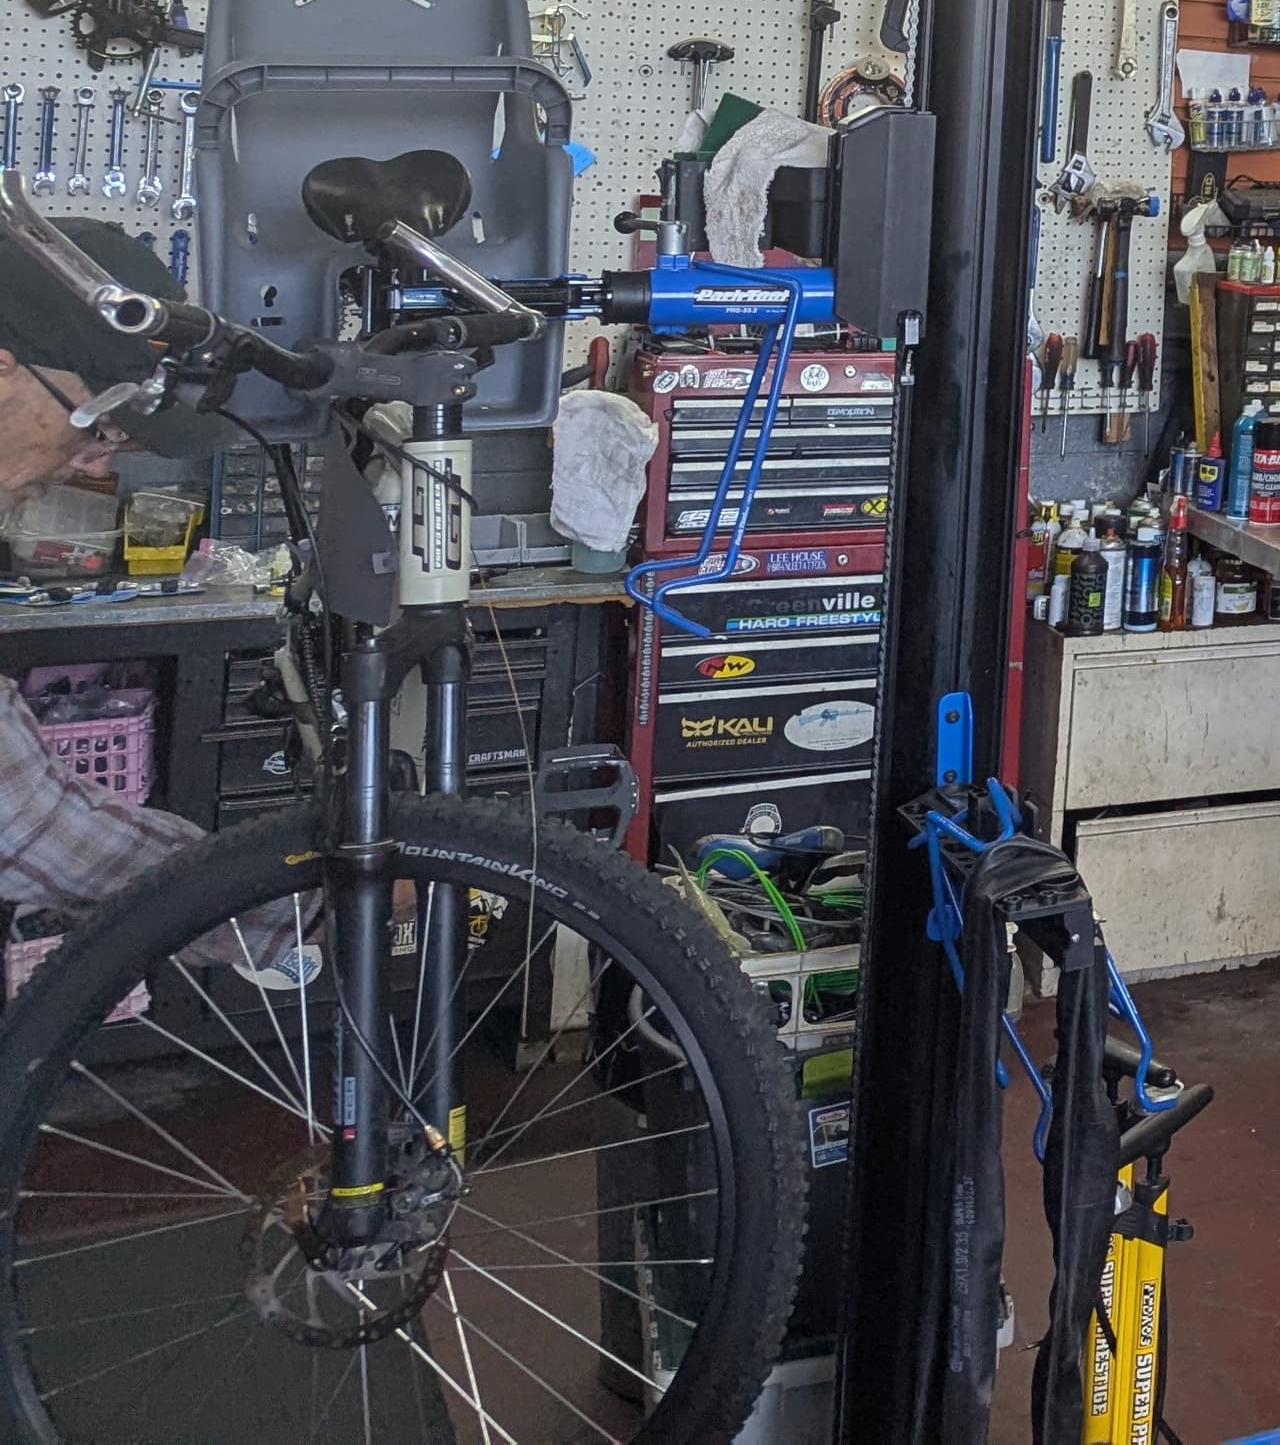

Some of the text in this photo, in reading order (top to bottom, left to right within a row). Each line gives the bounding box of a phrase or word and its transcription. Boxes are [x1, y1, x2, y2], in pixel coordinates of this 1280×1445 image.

[770, 551, 824, 563] LEE HOUSE
[738, 610, 880, 629] HARO FREESTYL
[718, 716, 774, 736] KALI
[686, 737, 767, 748] AUTHORIZED DEALER
[469, 748, 526, 763] CRAFTSMAN
[1134, 1354, 1154, 1421] SUPER
